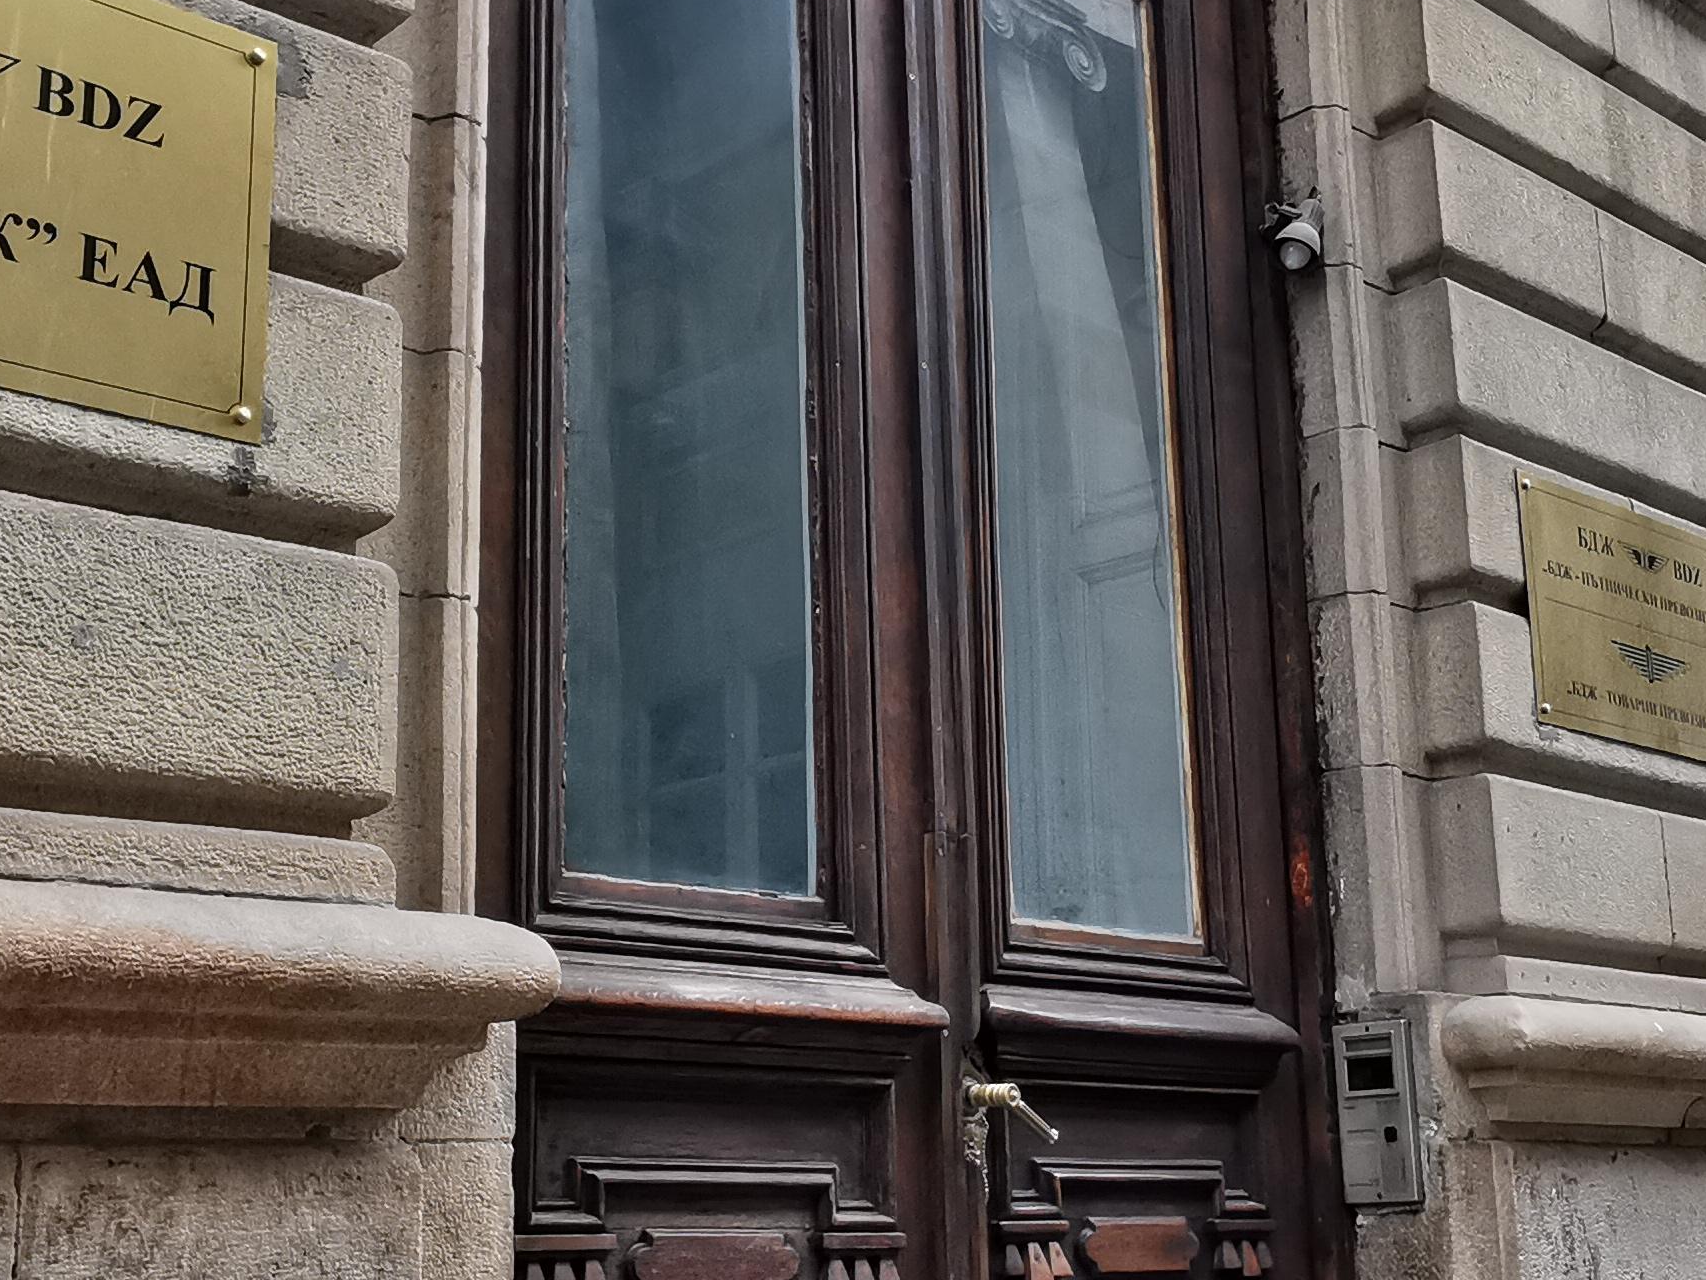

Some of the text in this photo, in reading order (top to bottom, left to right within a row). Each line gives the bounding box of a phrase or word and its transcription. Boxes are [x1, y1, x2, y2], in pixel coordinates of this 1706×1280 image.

[34, 65, 165, 148] BDZ
[77, 232, 217, 326] ЕАД
[1577, 526, 1614, 557] БДЖ
[1673, 560, 1703, 587] BDZ
